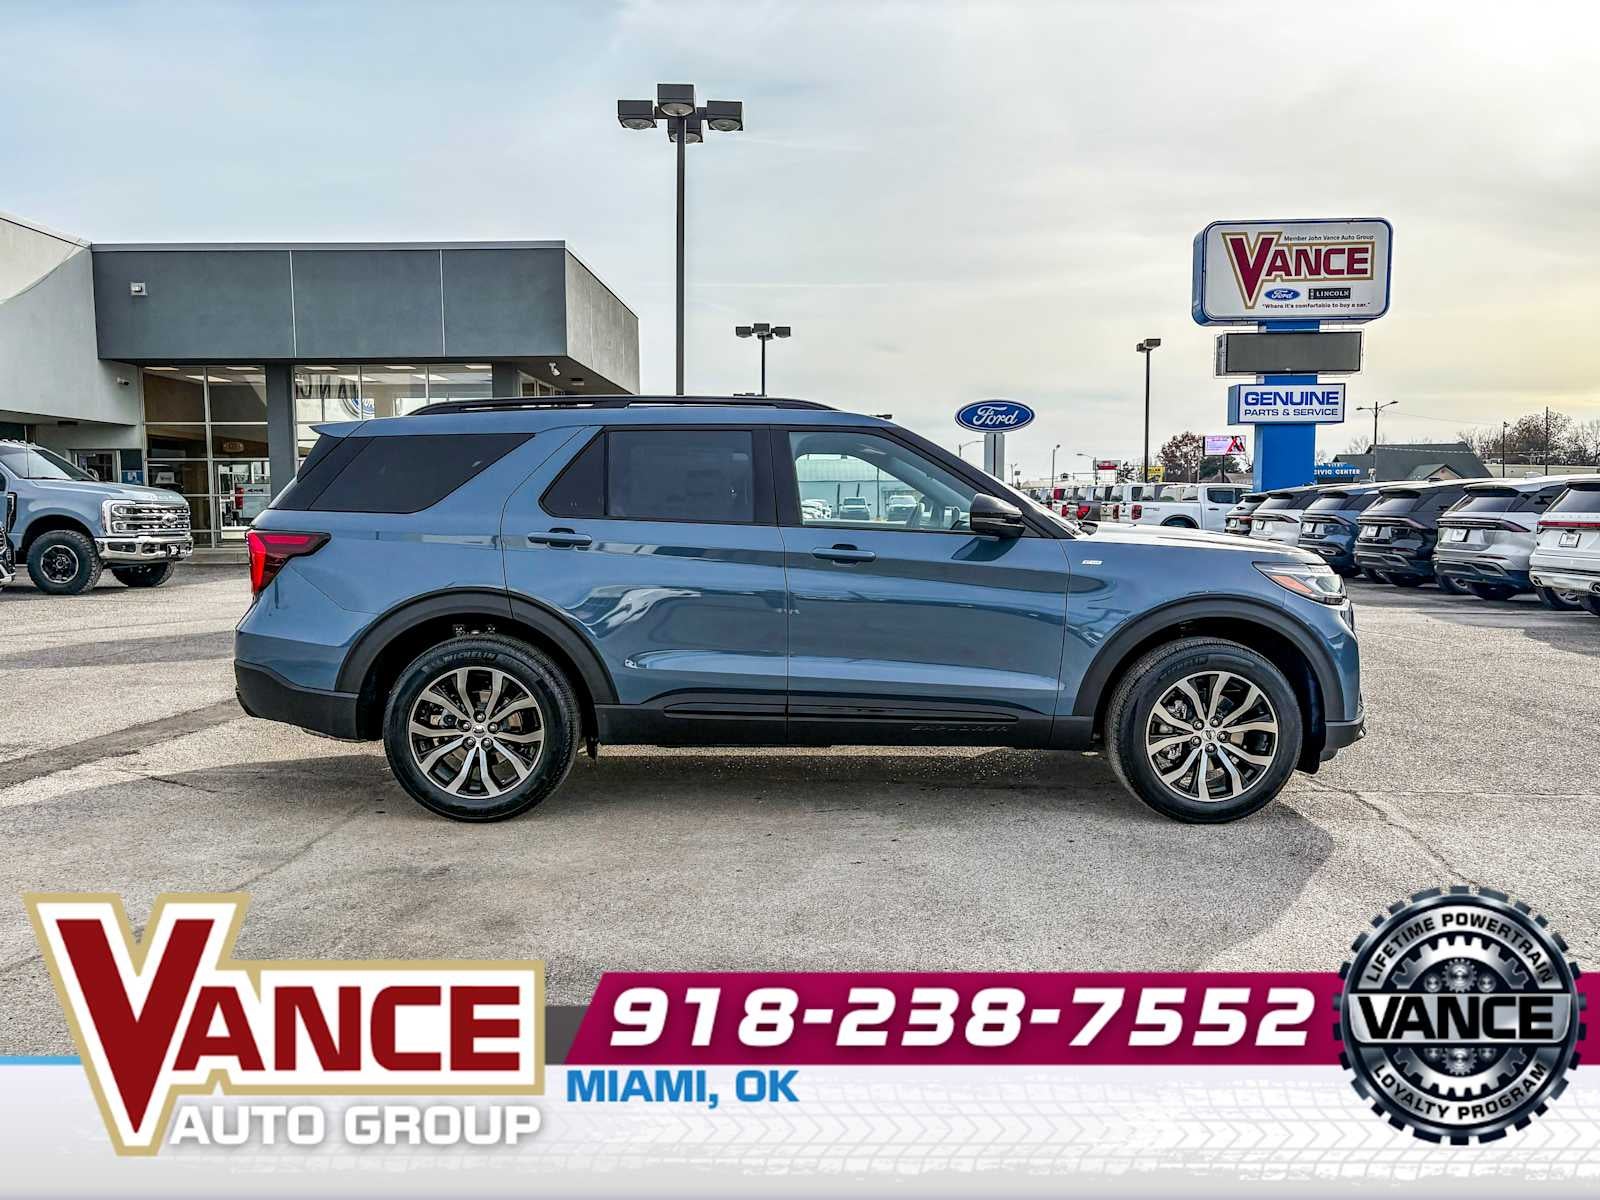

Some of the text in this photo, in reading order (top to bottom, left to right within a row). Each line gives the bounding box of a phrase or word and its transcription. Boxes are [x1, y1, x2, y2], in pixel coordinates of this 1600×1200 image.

[1229, 237, 1368, 303] VANCE
[1271, 290, 1294, 299] Ford
[1244, 391, 1339, 406] GENUINE
[973, 406, 1019, 425] Ford
[1244, 408, 1338, 416] PARTS & SERVICE
